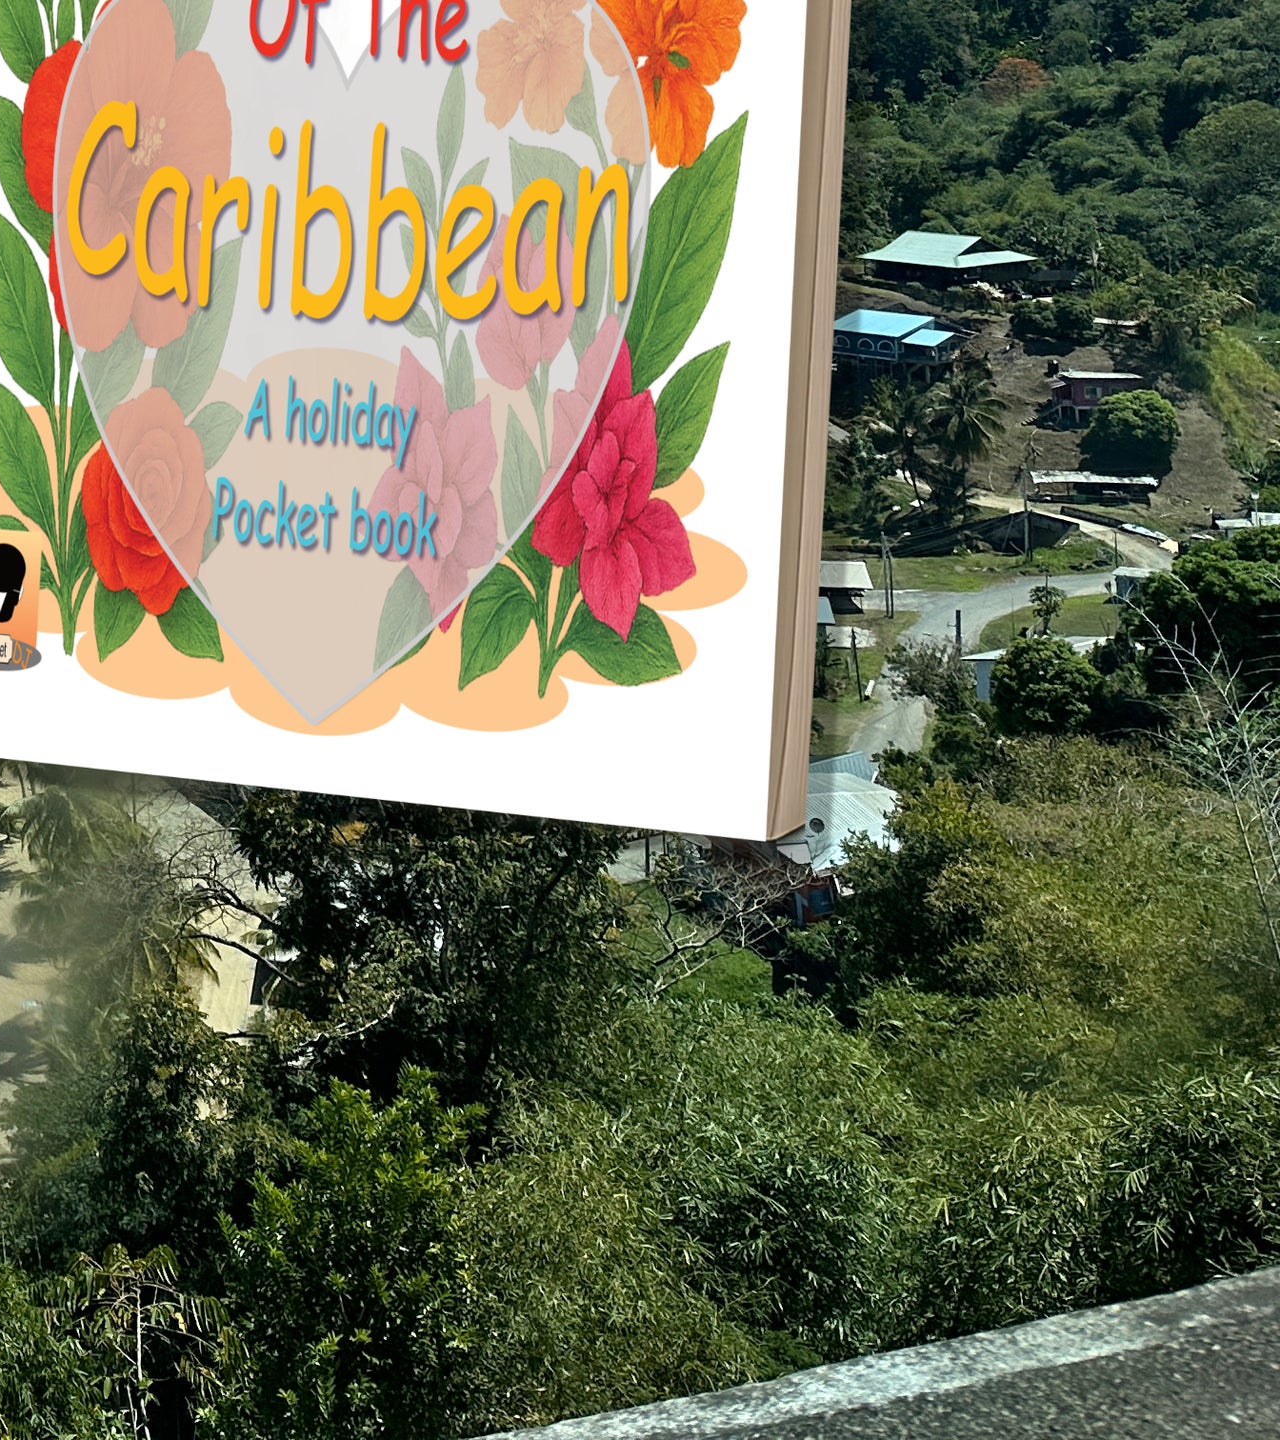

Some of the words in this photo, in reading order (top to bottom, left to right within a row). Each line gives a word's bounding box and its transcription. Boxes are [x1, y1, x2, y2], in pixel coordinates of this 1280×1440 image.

[66, 100, 631, 321] Caribbean
[243, 378, 271, 441] A
[285, 375, 417, 468] holiday
[212, 477, 338, 548] Pocket
[349, 486, 439, 557] book
